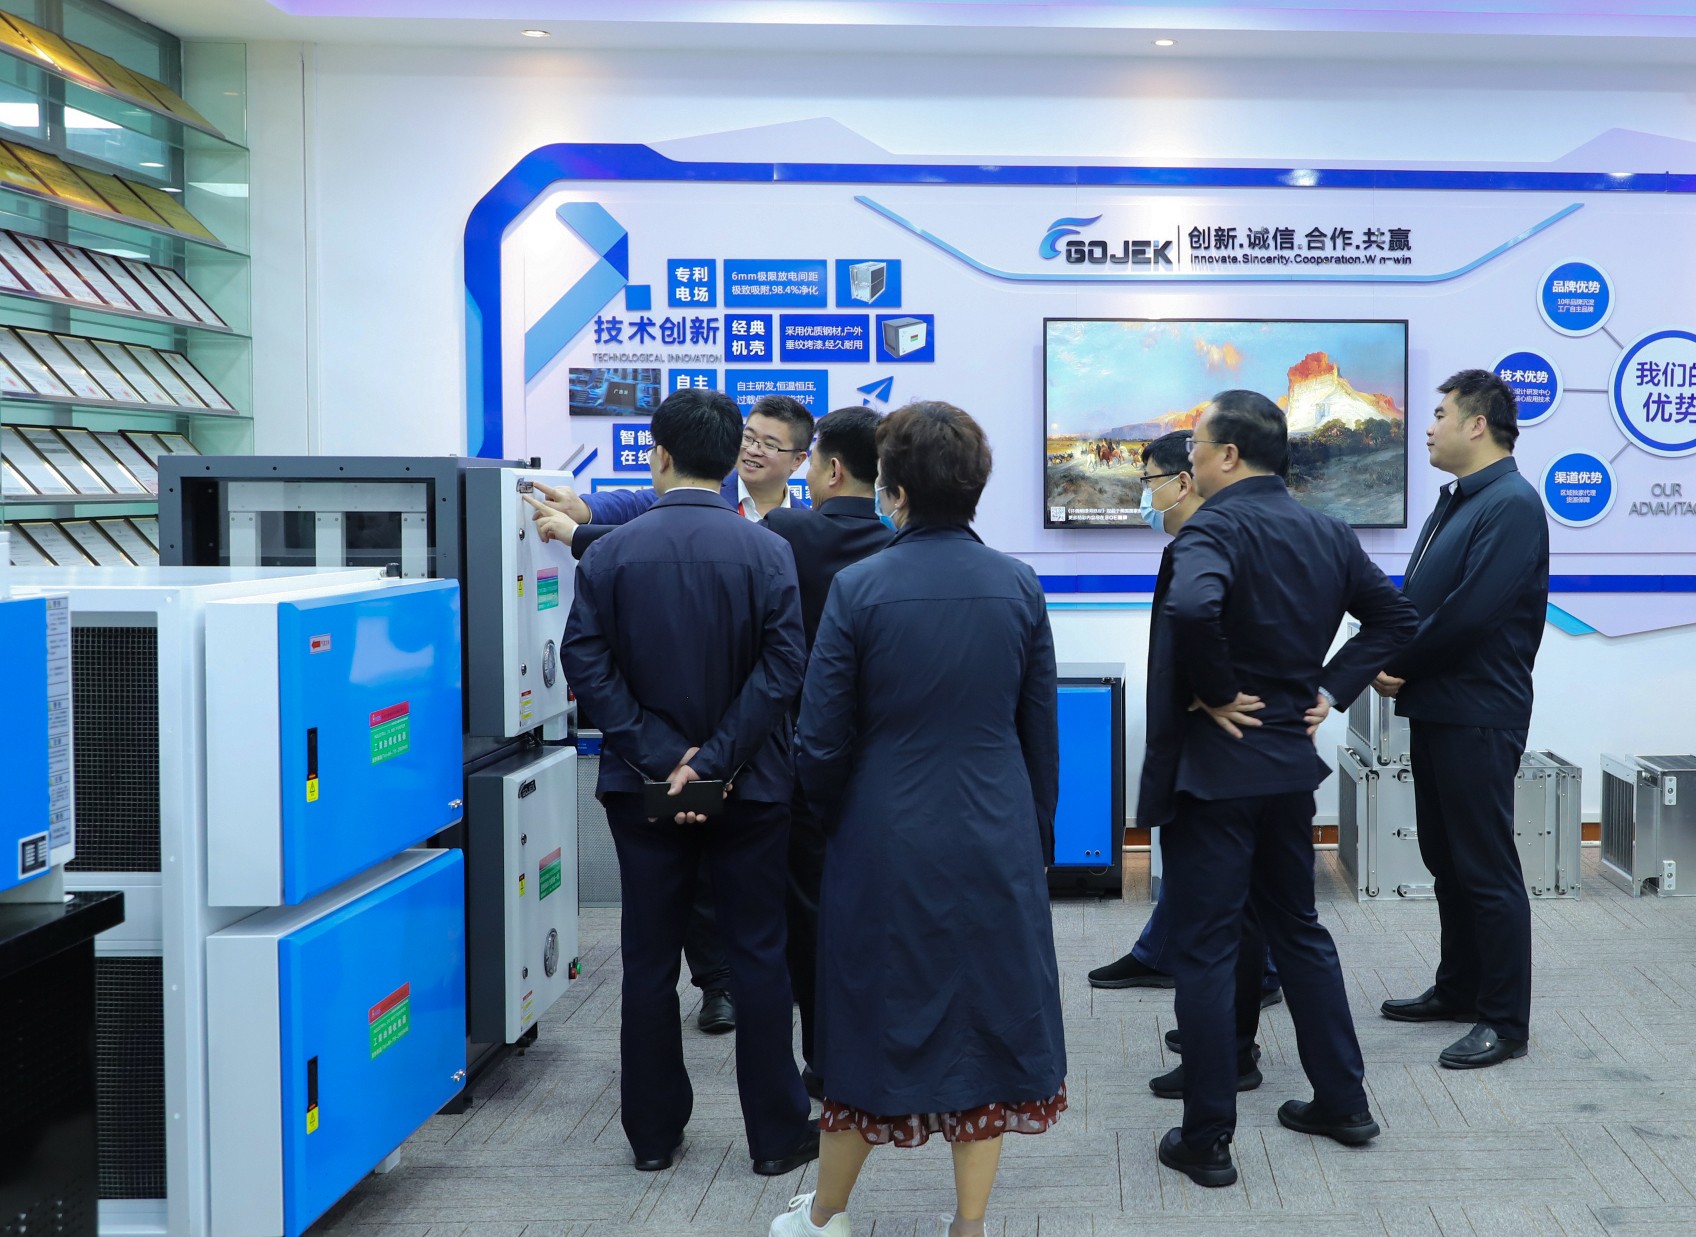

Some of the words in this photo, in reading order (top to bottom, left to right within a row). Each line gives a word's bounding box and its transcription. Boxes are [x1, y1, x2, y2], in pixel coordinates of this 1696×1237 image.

[1065, 240, 1173, 264] GOJEK
[675, 266, 708, 283] 专利
[731, 271, 819, 282] 6mm极限放电间距
[675, 286, 709, 302] 电场
[731, 285, 819, 296] 极致吸附,98.4%净化
[1552, 280, 1600, 293] 品牌优势
[594, 315, 720, 345] 技术创新
[731, 320, 765, 336] 经典
[785, 326, 863, 336] 采用优质钢材,户外
[731, 340, 765, 356] 机壳
[592, 352, 665, 363] TECHNOLOGICAL
[667, 353, 722, 364] INNOVATION
[676, 375, 709, 390] 自主
[1500, 369, 1549, 383] 技术优势
[1642, 391, 1696, 424] 优势
[620, 430, 653, 446] 智能
[1554, 471, 1603, 484] 渠道优势
[1651, 483, 1682, 498] OUR
